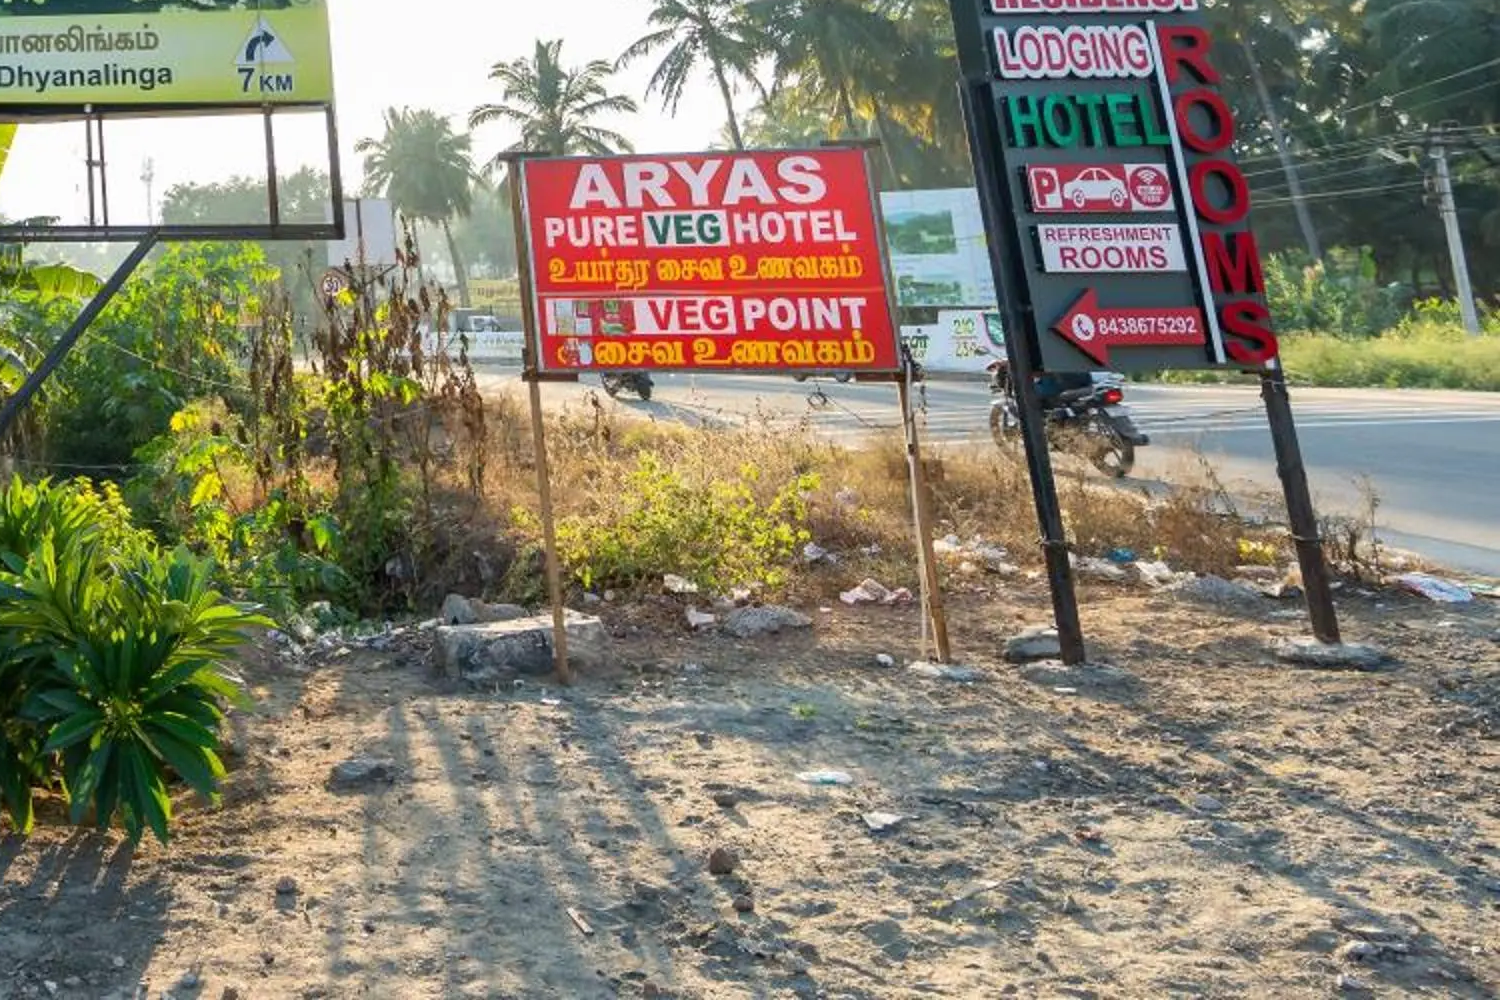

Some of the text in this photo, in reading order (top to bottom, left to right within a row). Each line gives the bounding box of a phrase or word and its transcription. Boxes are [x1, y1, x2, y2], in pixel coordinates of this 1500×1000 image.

[996, 29, 1152, 74] LODGING
[236, 67, 294, 93] 7 KM
[1008, 88, 1172, 148] HOTEL
[569, 155, 828, 209] ARYAS
[1157, 25, 1280, 364] ROOMS
[544, 209, 857, 248] PURE VEG HOTEL
[1044, 227, 1172, 242] REFRESHMENT
[548, 242, 864, 291] உயர்தர சைவ உணவகம்
[1058, 245, 1168, 270] ROOMS
[648, 299, 730, 331] VEG
[743, 296, 867, 331] POINT
[1098, 316, 1198, 336] 8438675292
[557, 340, 687, 366] சைவ
[692, 329, 875, 366] உணவகம்
